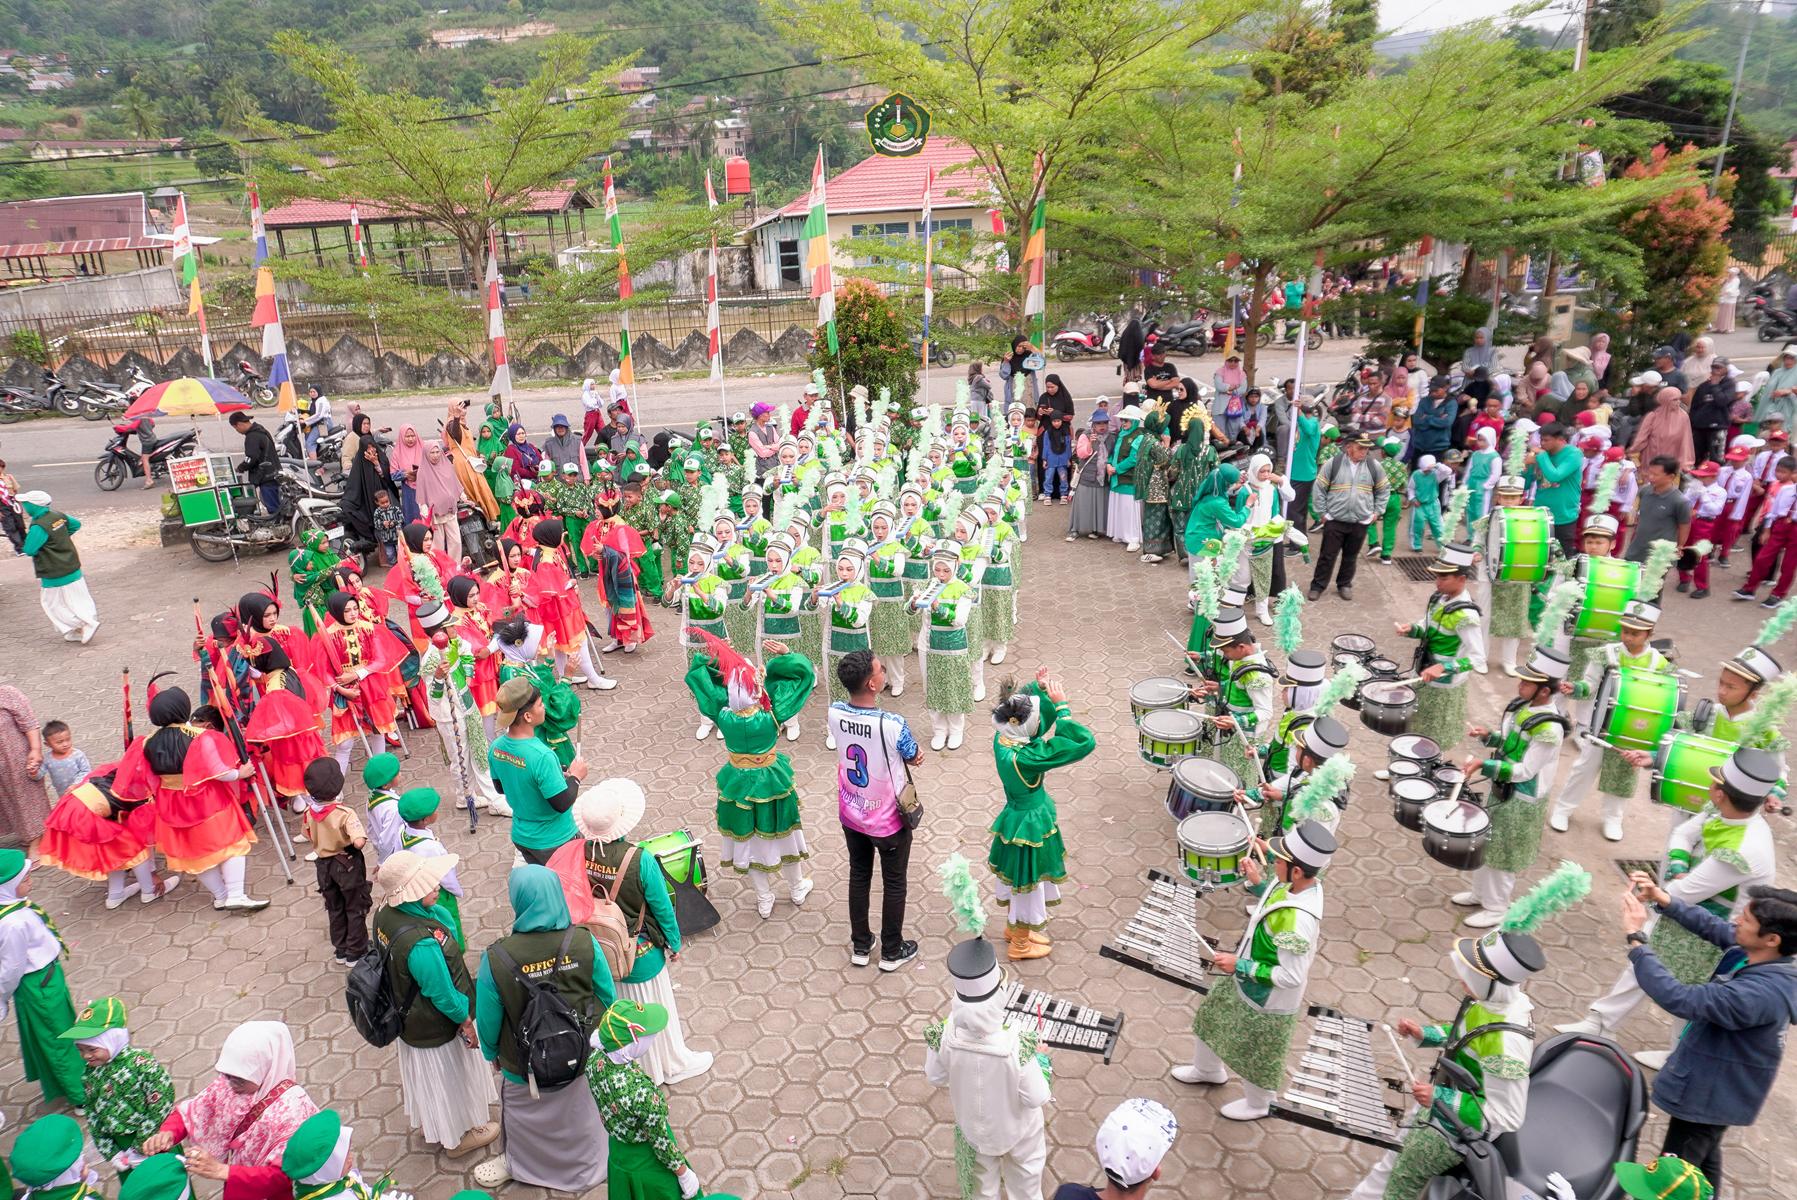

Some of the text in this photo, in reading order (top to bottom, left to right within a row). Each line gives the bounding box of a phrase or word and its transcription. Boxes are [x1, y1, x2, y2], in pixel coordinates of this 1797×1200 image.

[840, 718, 872, 739] CHUA
[846, 743, 869, 788] 3
[585, 860, 617, 875] FFICIAL
